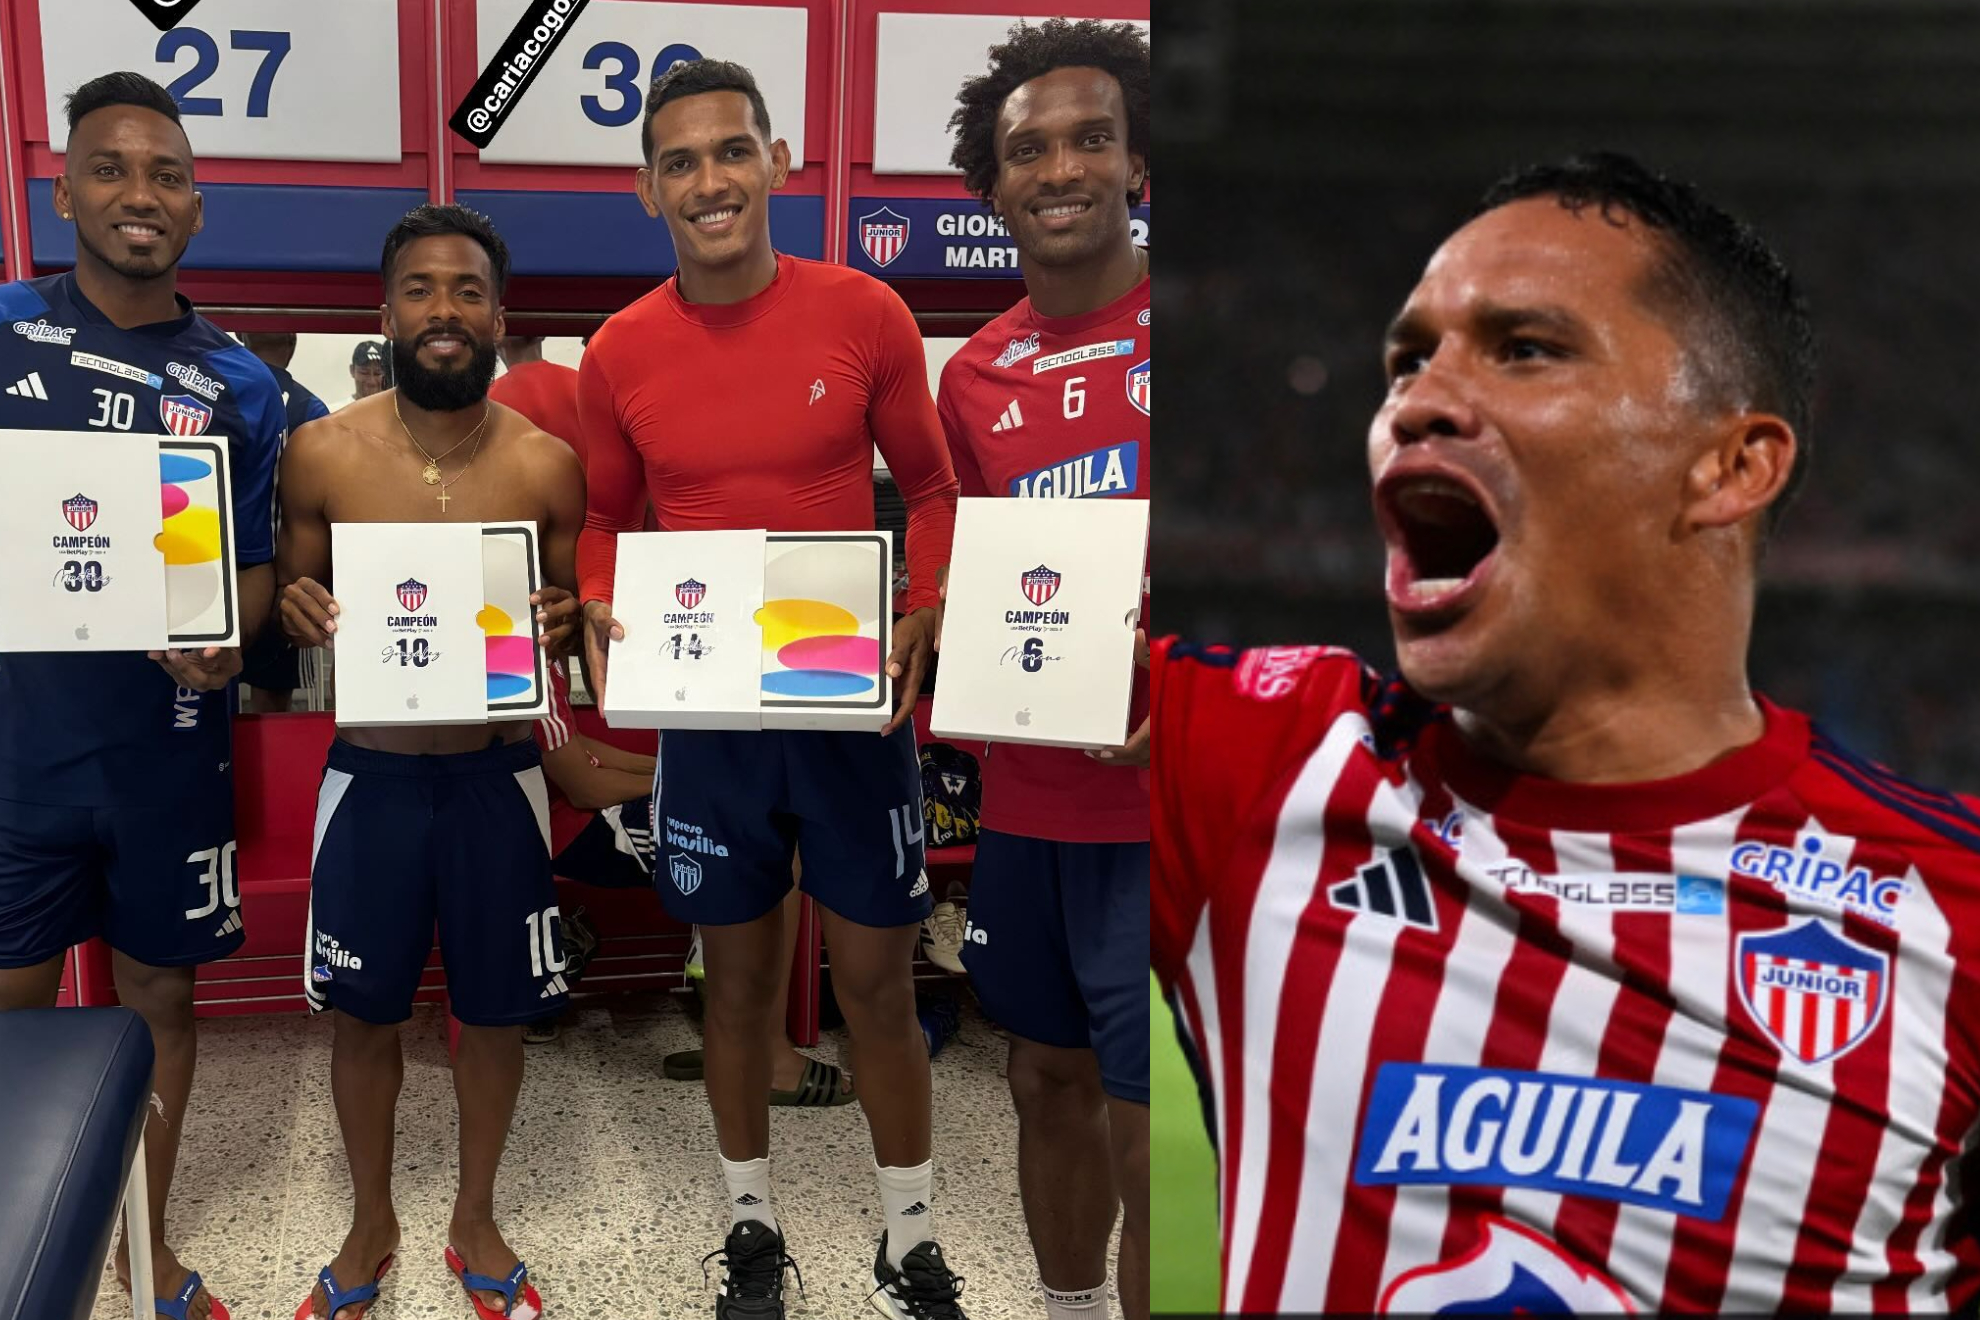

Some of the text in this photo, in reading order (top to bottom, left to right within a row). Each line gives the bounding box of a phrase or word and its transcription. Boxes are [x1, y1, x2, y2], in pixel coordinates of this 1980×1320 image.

[155, 27, 291, 117] 27
[868, 229, 901, 237] JUNIOR
[936, 213, 1010, 237] GIOR
[945, 246, 1019, 268] MART
[1135, 378, 1150, 387] JU
[88, 387, 135, 431] 30
[170, 405, 203, 420] JUNIOR
[1062, 377, 1087, 420] 6
[53, 534, 111, 549] CAMPEÓN
[387, 613, 438, 627] CAMPEÓN
[1005, 608, 1070, 625] CAMPEÓN
[396, 637, 429, 668] 10
[671, 633, 702, 660] 14
[1022, 637, 1044, 673] 6
[185, 840, 241, 920] 30
[1731, 837, 1903, 913] GRIPAC
[525, 906, 566, 978] 10
[1762, 966, 1861, 997] JUNIOR
[1372, 1074, 1714, 1206] AGUILA
